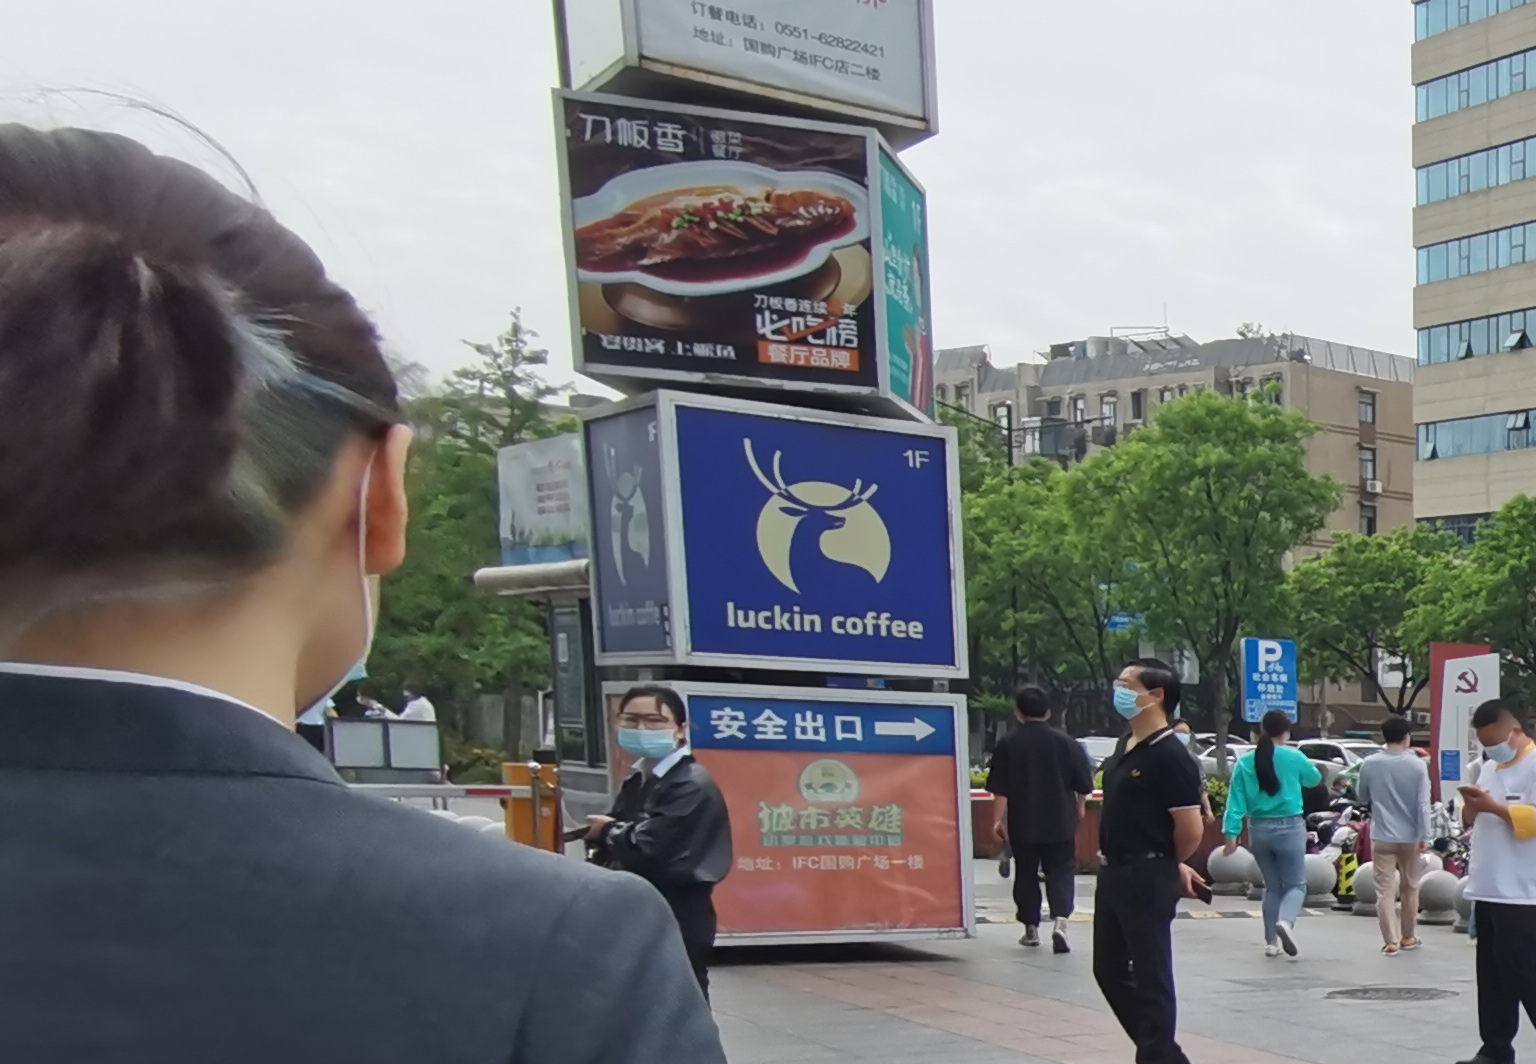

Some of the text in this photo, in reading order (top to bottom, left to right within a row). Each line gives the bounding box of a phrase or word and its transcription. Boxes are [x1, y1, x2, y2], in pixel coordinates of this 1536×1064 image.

[753, 293, 858, 316] 刀板香连续年
[756, 310, 859, 348] 必吃榜
[768, 345, 851, 369] 餐厅品牌
[902, 449, 930, 469] 1F
[726, 602, 924, 639] luckin coffee
[1258, 640, 1282, 672] P
[709, 706, 864, 743] 安全出口
